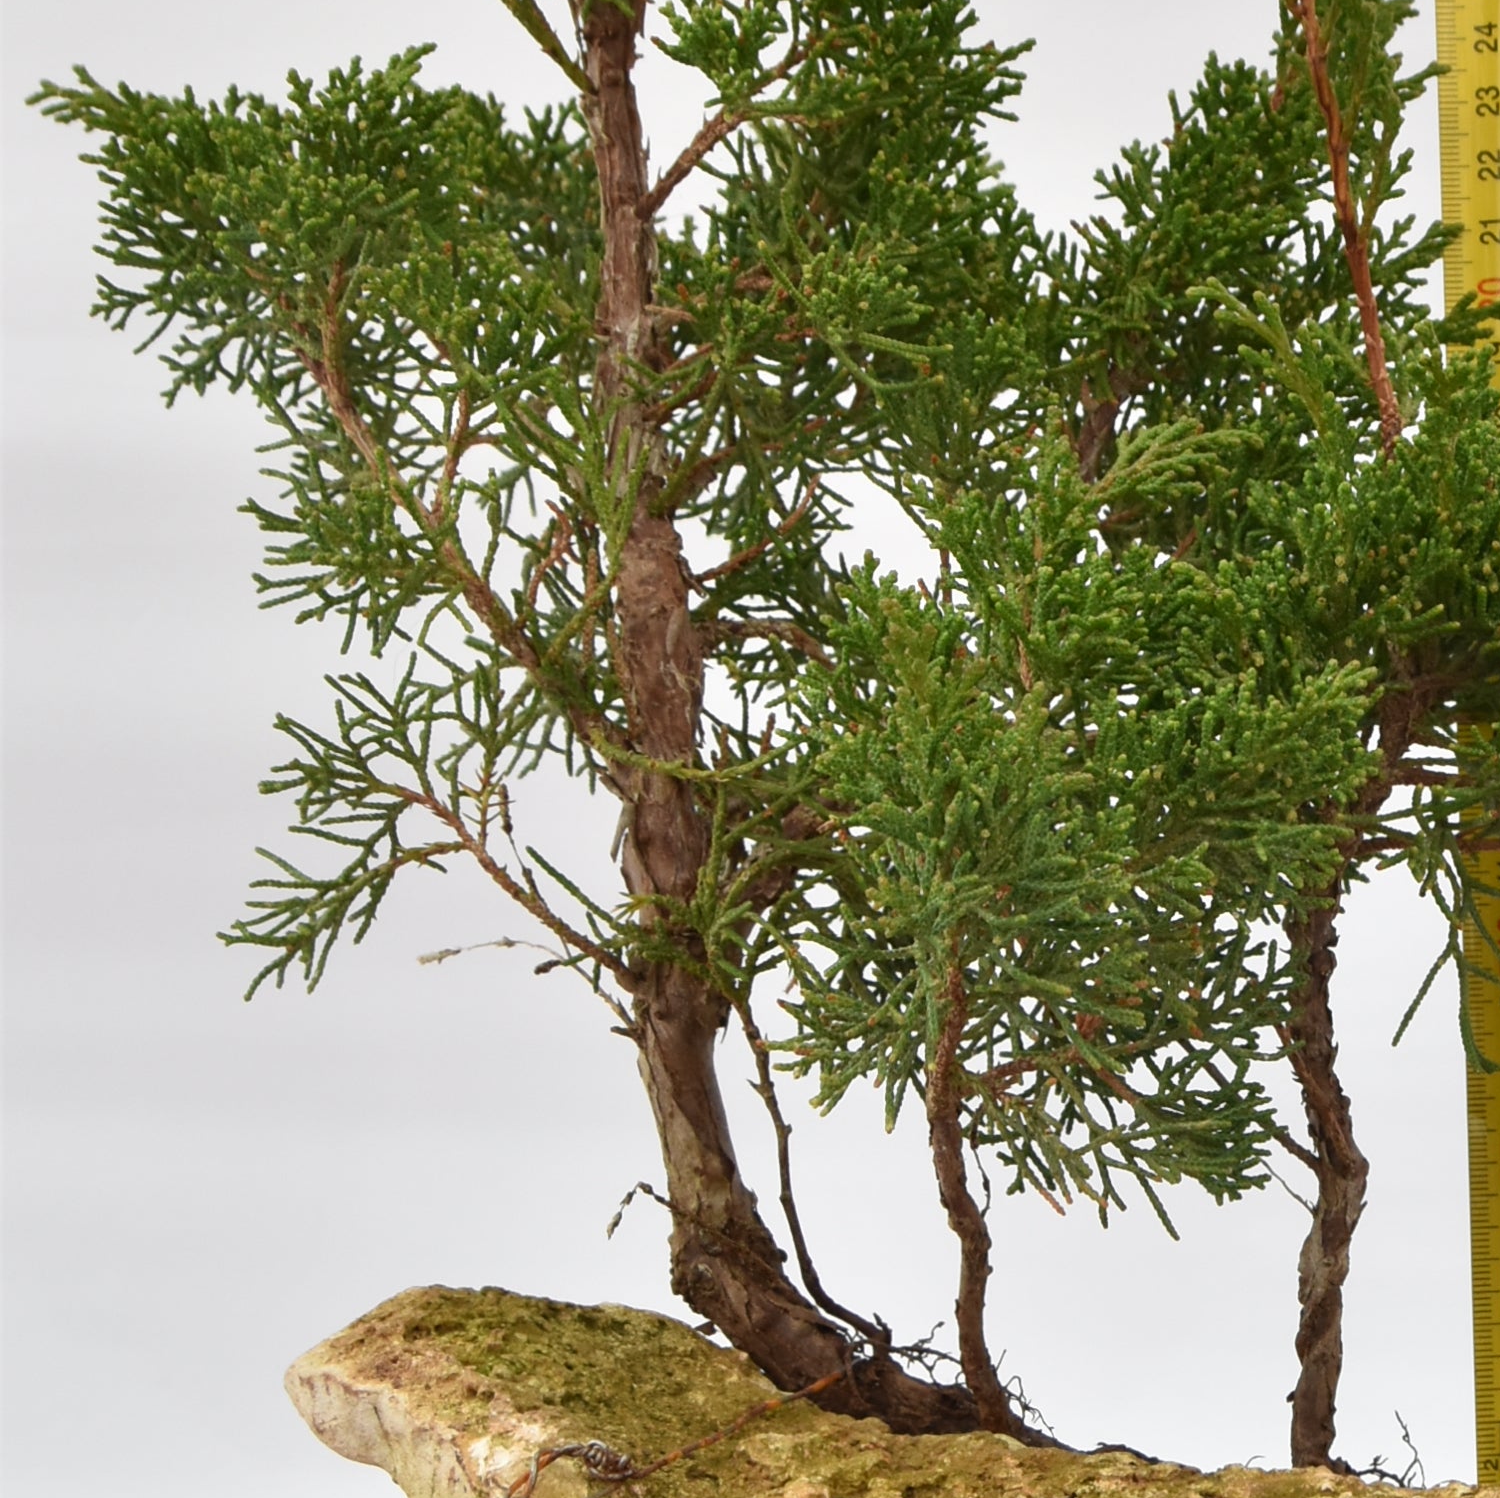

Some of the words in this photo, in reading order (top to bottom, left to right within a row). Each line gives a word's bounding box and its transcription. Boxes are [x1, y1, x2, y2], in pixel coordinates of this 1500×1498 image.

[1473, 21, 1499, 54] 24
[1475, 85, 1500, 118] 23
[1484, 1458, 1499, 1471] 2
